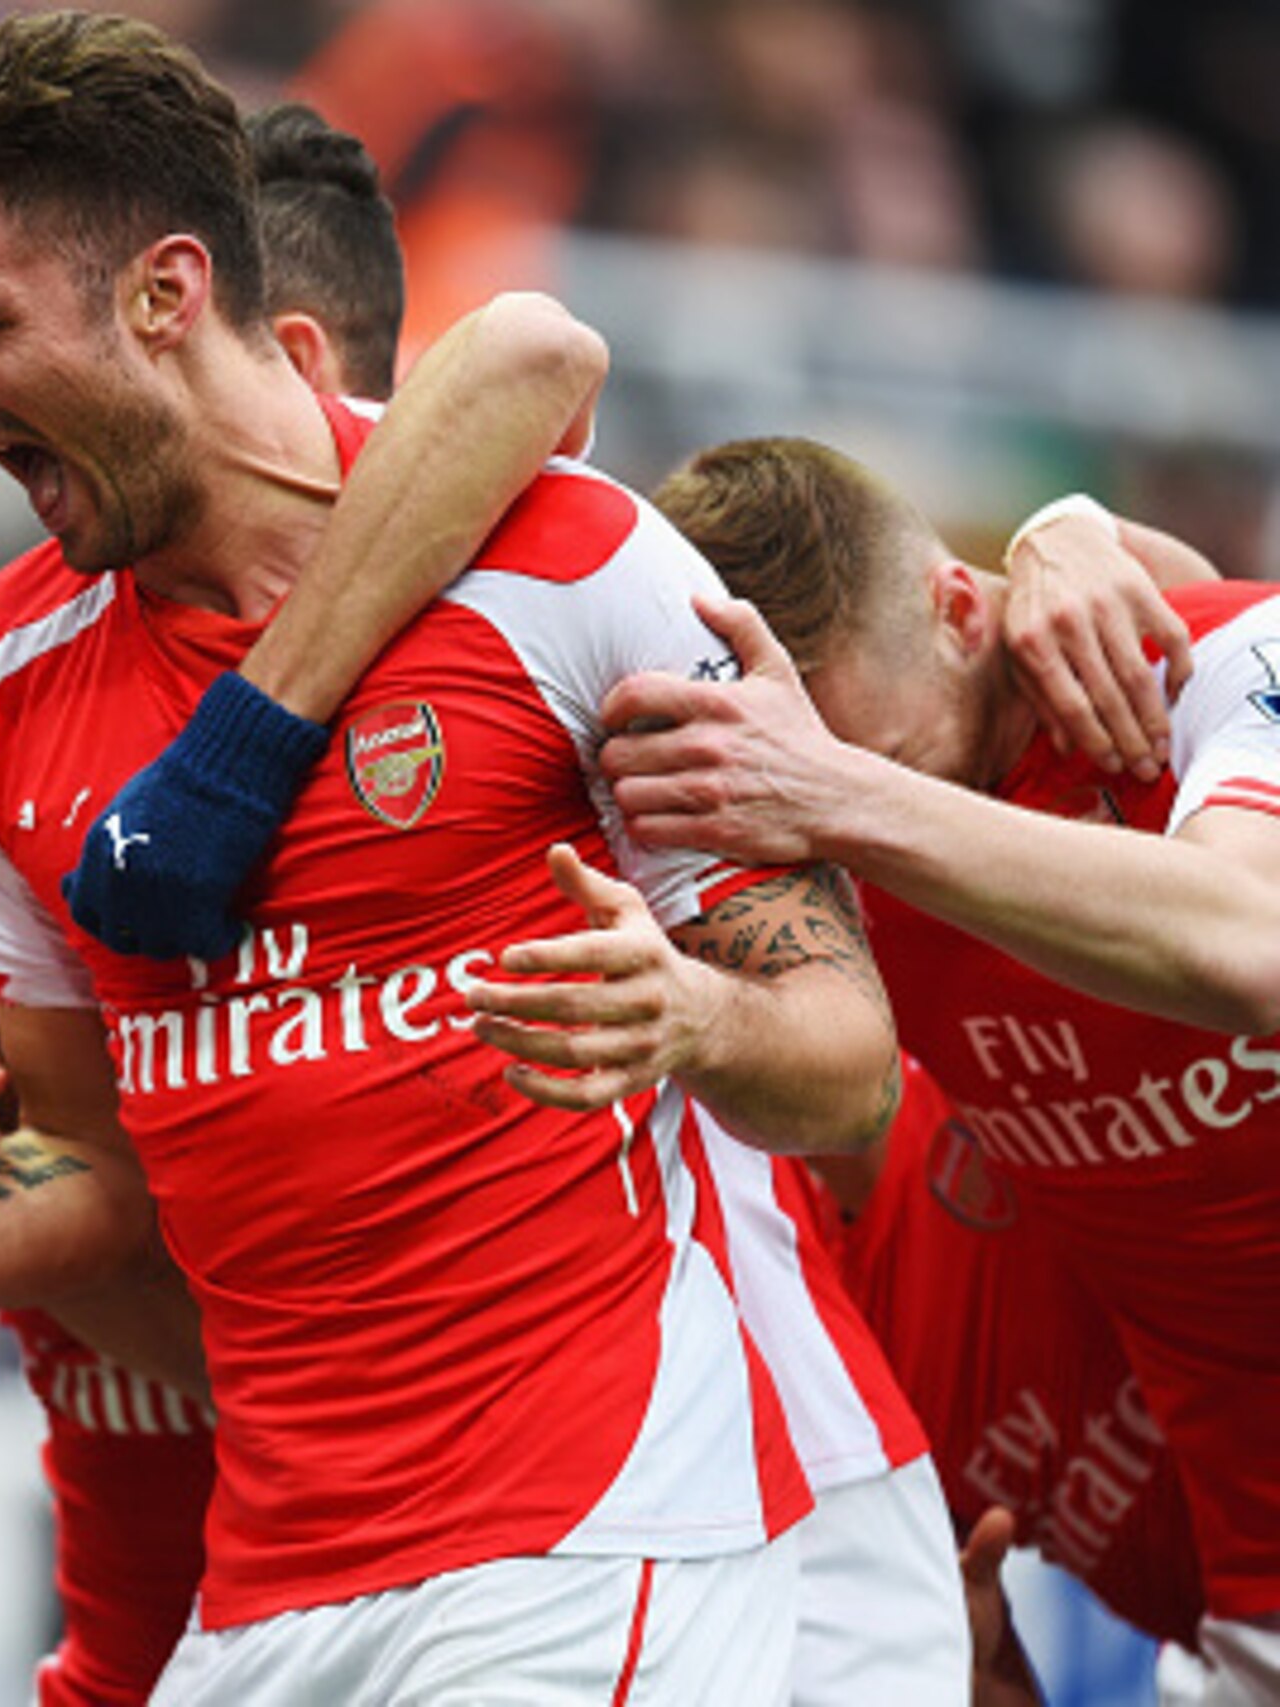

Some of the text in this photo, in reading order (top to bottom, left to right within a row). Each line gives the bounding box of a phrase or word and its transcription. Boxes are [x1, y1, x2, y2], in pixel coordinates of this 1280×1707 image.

[108, 949, 496, 1095] mirates
[961, 1014, 1089, 1082] Fly
[960, 1035, 1280, 1168] mirates
